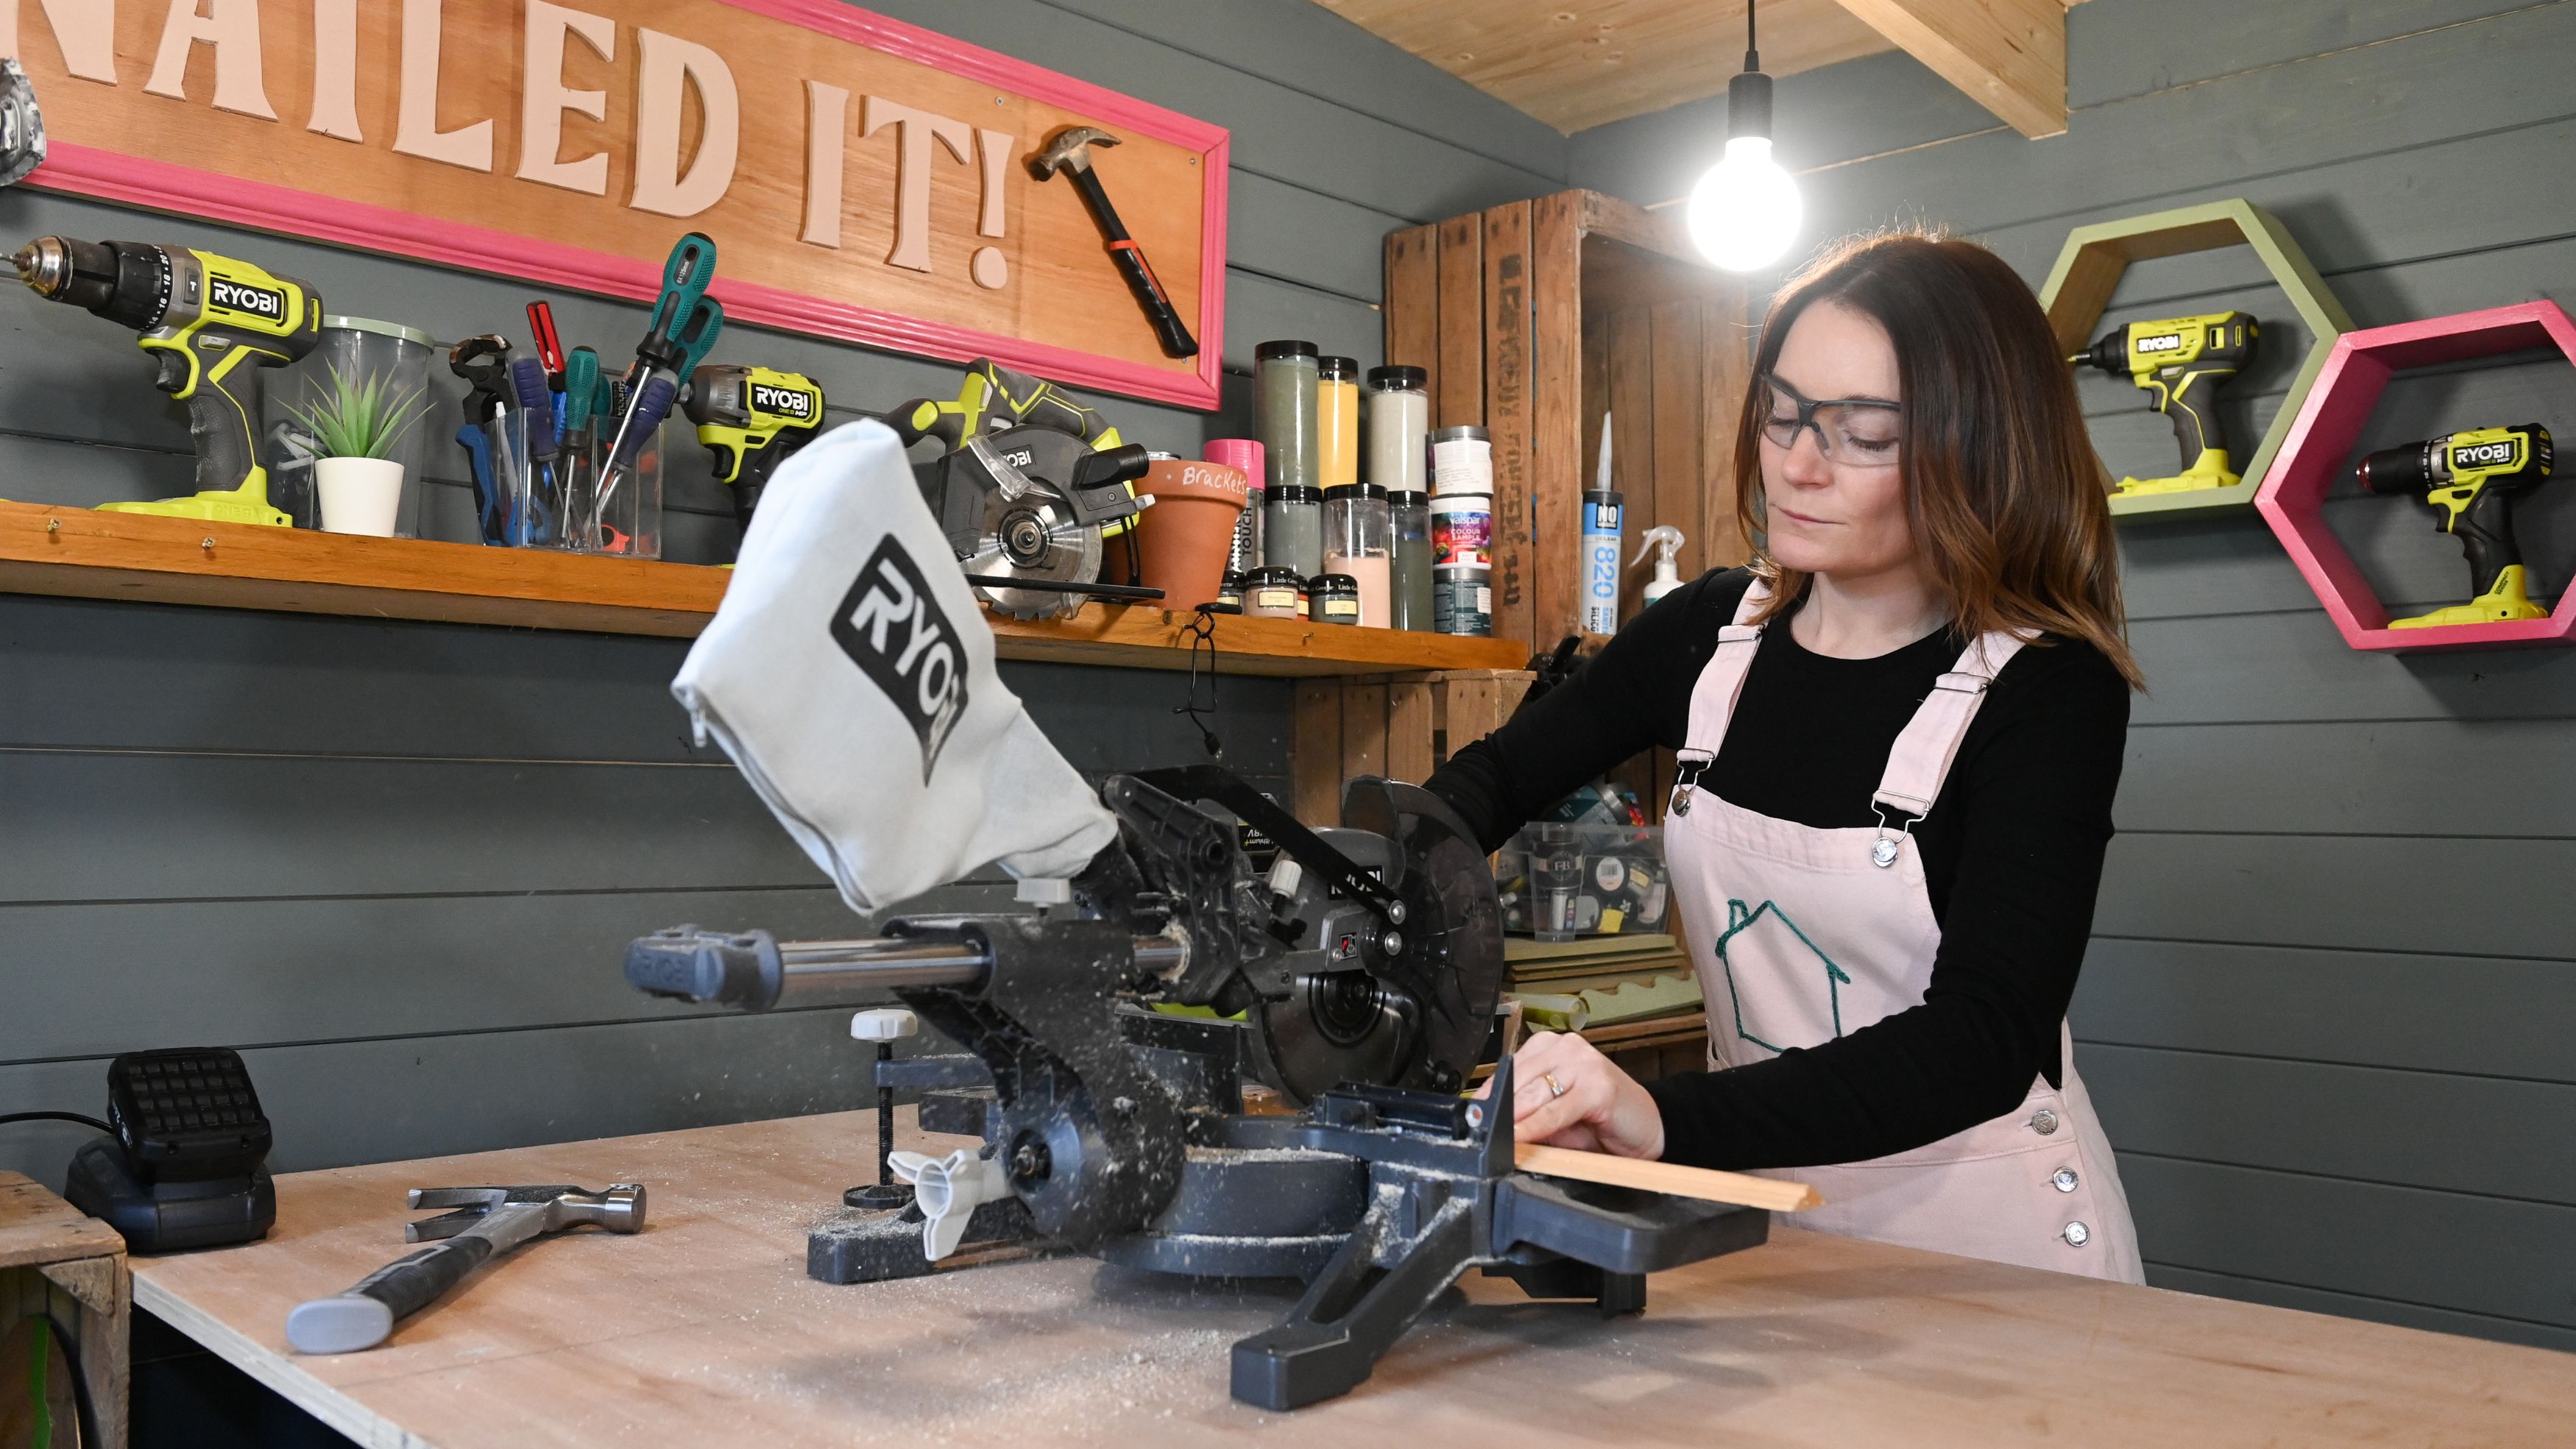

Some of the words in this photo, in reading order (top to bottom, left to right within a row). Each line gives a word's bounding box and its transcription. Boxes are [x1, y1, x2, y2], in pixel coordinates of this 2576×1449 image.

[801, 79, 1014, 290] IT!
[160, 255, 169, 264] 20
[163, 274, 171, 286] 18
[159, 297, 167, 308] 16
[213, 282, 278, 313] RYOBI
[2138, 336, 2179, 352] RYOBI
[755, 386, 808, 411] RYOBI
[1002, 450, 1032, 467] OBI
[2455, 444, 2510, 463] RYOBI
[1183, 467, 1247, 495] Brackets
[1449, 515, 1481, 526] valspar
[1242, 508, 1252, 556] TOUCH
[1592, 547, 1616, 598] 820
[849, 557, 960, 761] RYO
